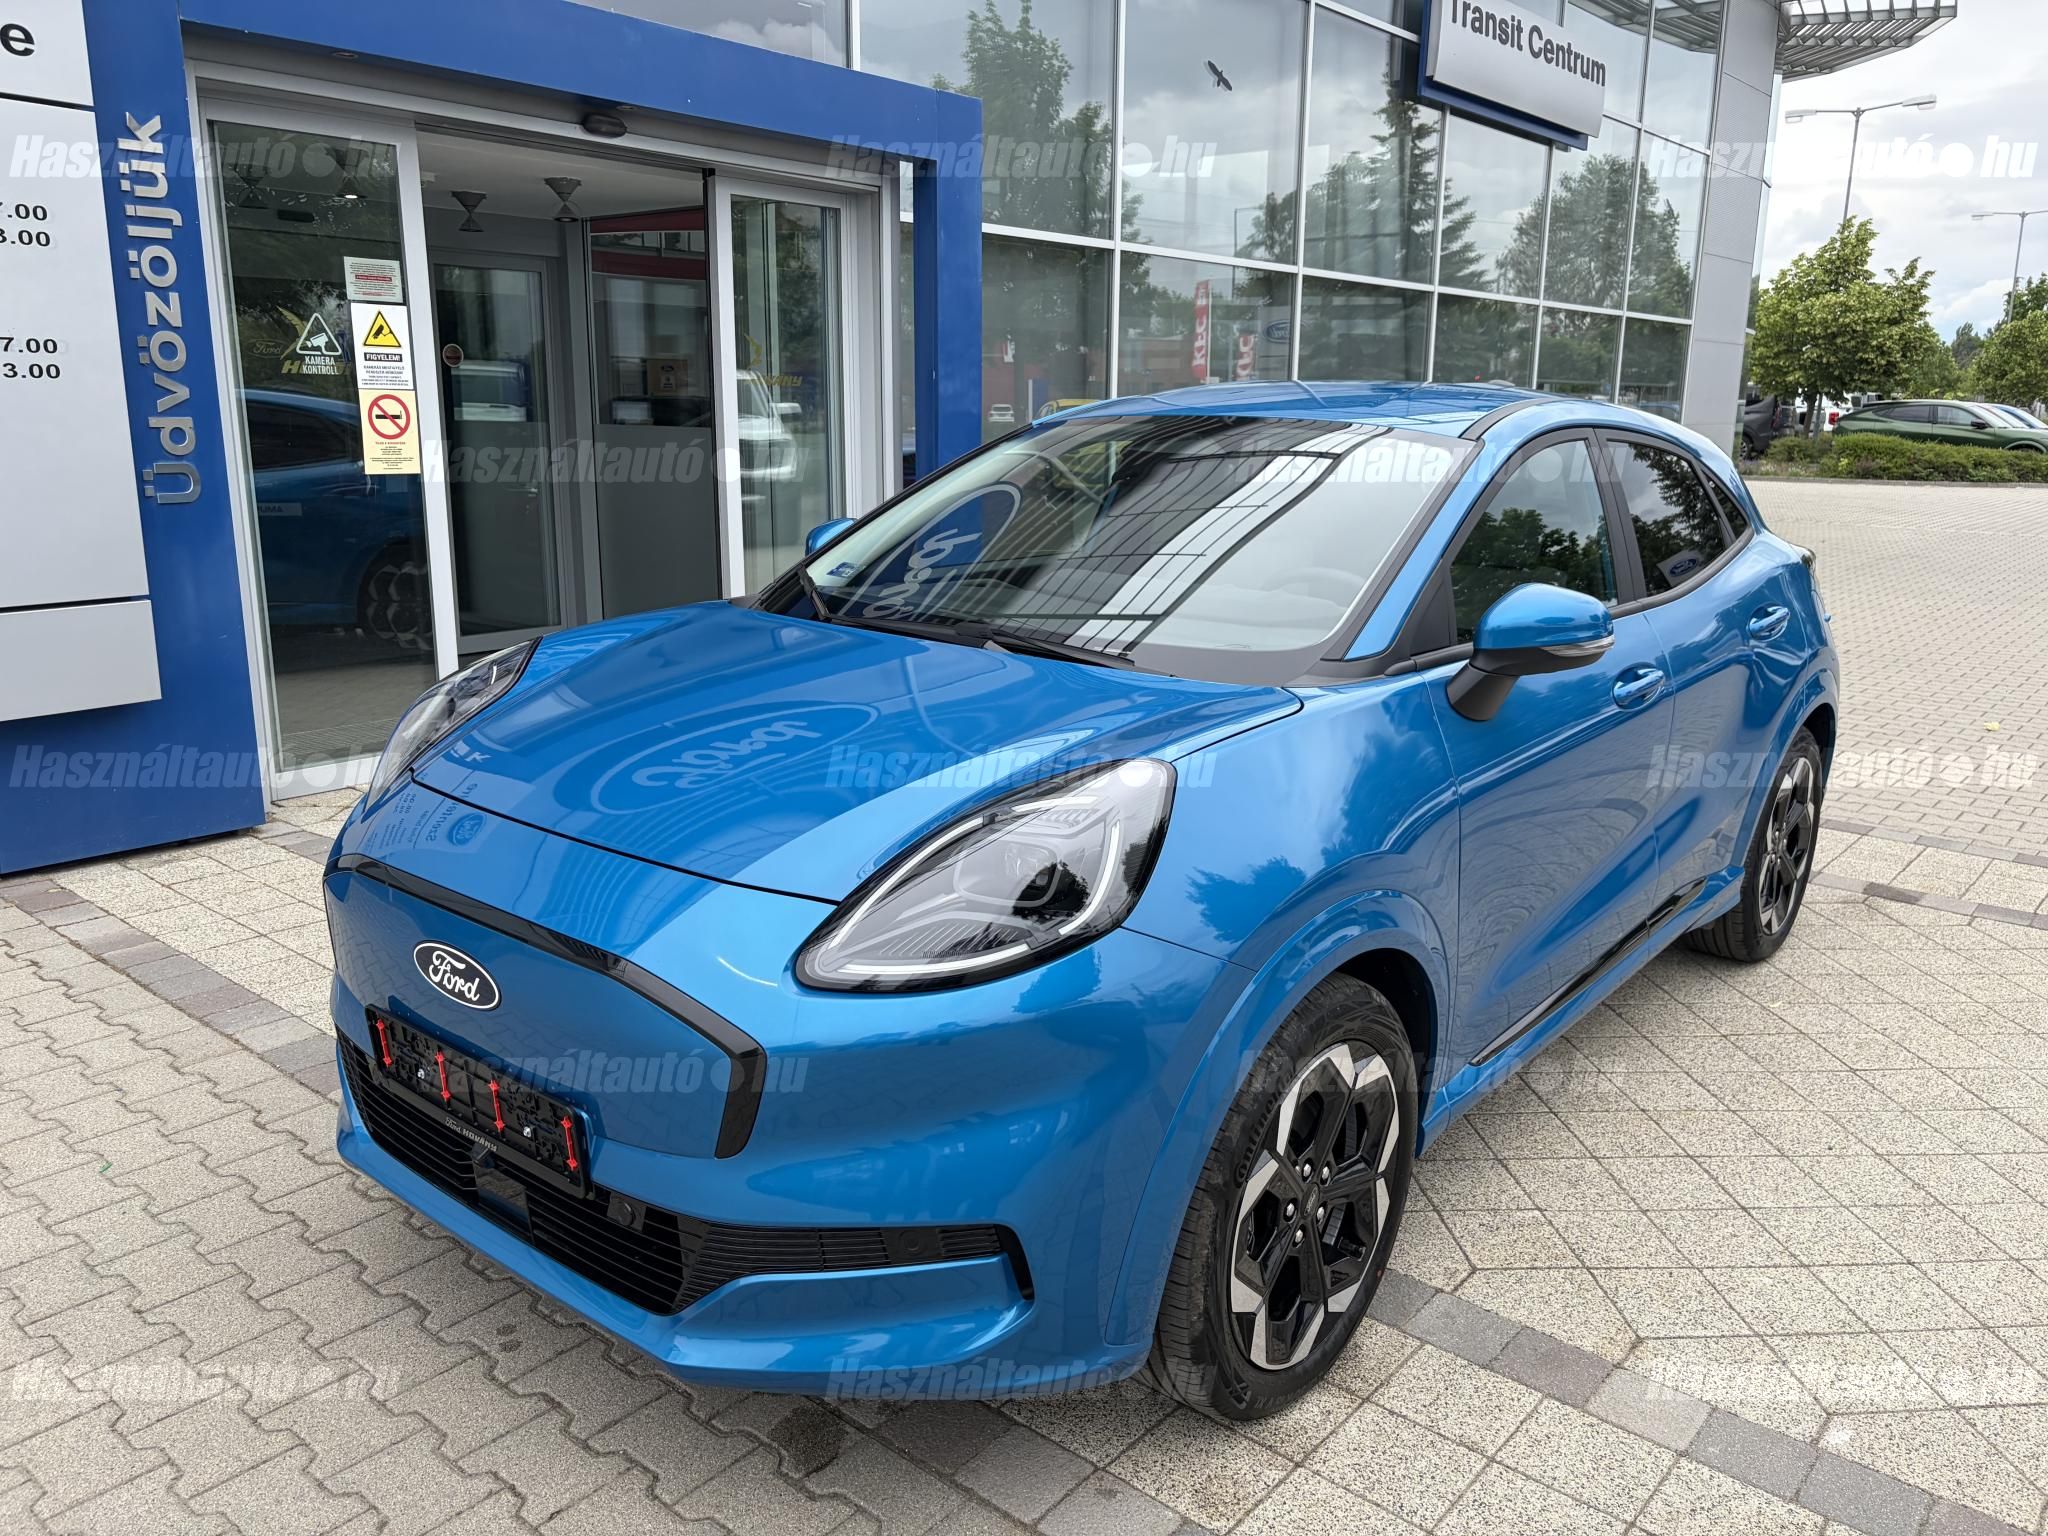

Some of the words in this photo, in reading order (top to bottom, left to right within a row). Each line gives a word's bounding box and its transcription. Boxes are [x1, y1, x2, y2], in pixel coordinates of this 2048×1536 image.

[1528, 24, 1606, 86] Centrum
[117, 111, 203, 505] Üdvözöljük
[302, 365, 340, 375] KONTROLL
[305, 355, 336, 366] KAMERA
[366, 353, 401, 361] FIGYELEM!
[428, 950, 481, 1001] Ford
